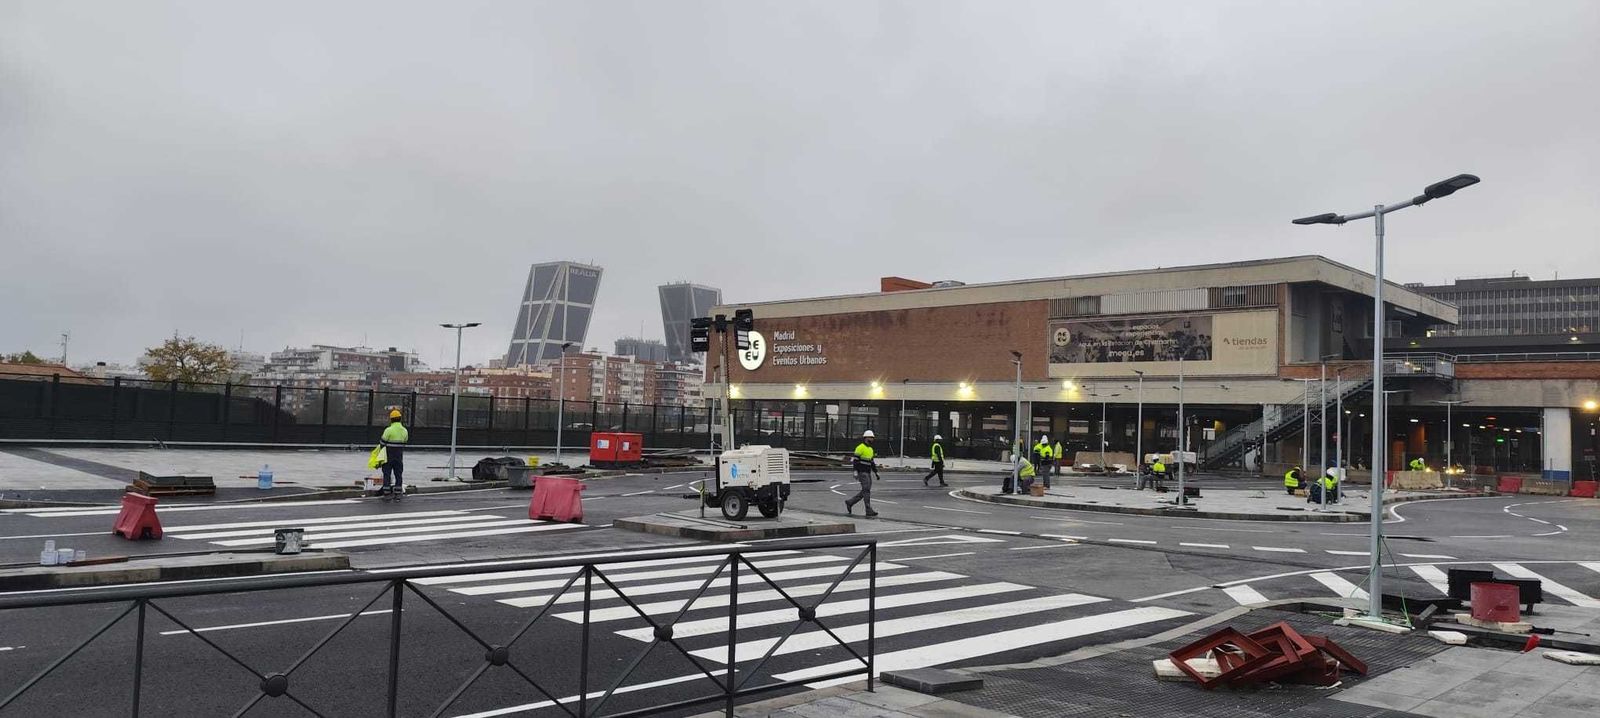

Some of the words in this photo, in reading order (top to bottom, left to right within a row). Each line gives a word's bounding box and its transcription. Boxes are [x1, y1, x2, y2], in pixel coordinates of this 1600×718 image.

[774, 330, 795, 340] Madrid
[1232, 337, 1268, 345] tiendas
[773, 343, 814, 355] Exposiciones
[817, 344, 822, 353] y
[772, 355, 798, 366] Eventos
[799, 355, 827, 365] Urbanos
